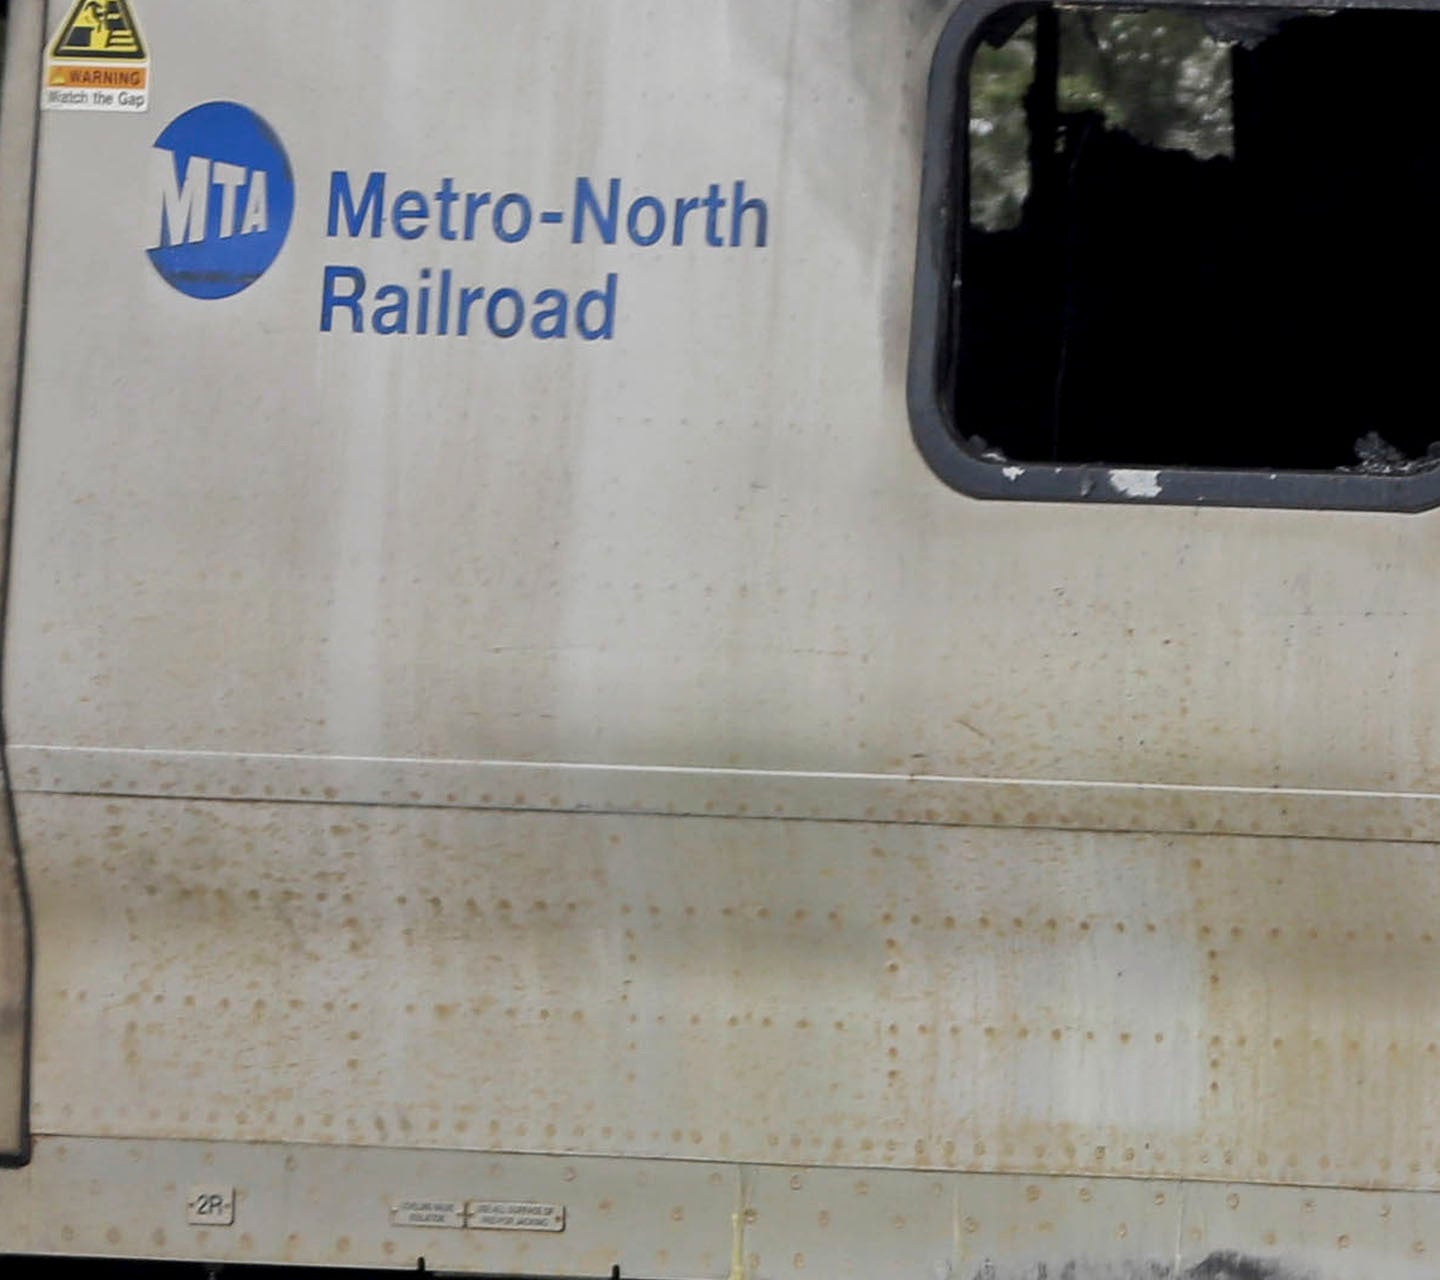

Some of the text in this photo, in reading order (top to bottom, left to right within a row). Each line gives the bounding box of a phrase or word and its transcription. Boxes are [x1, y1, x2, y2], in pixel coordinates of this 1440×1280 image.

[70, 70, 140, 86] WARNING
[93, 90, 113, 105] the
[118, 91, 145, 108] Gap
[146, 146, 269, 253] MTA
[326, 170, 768, 248] Metro-North
[319, 265, 618, 341] Railroad
